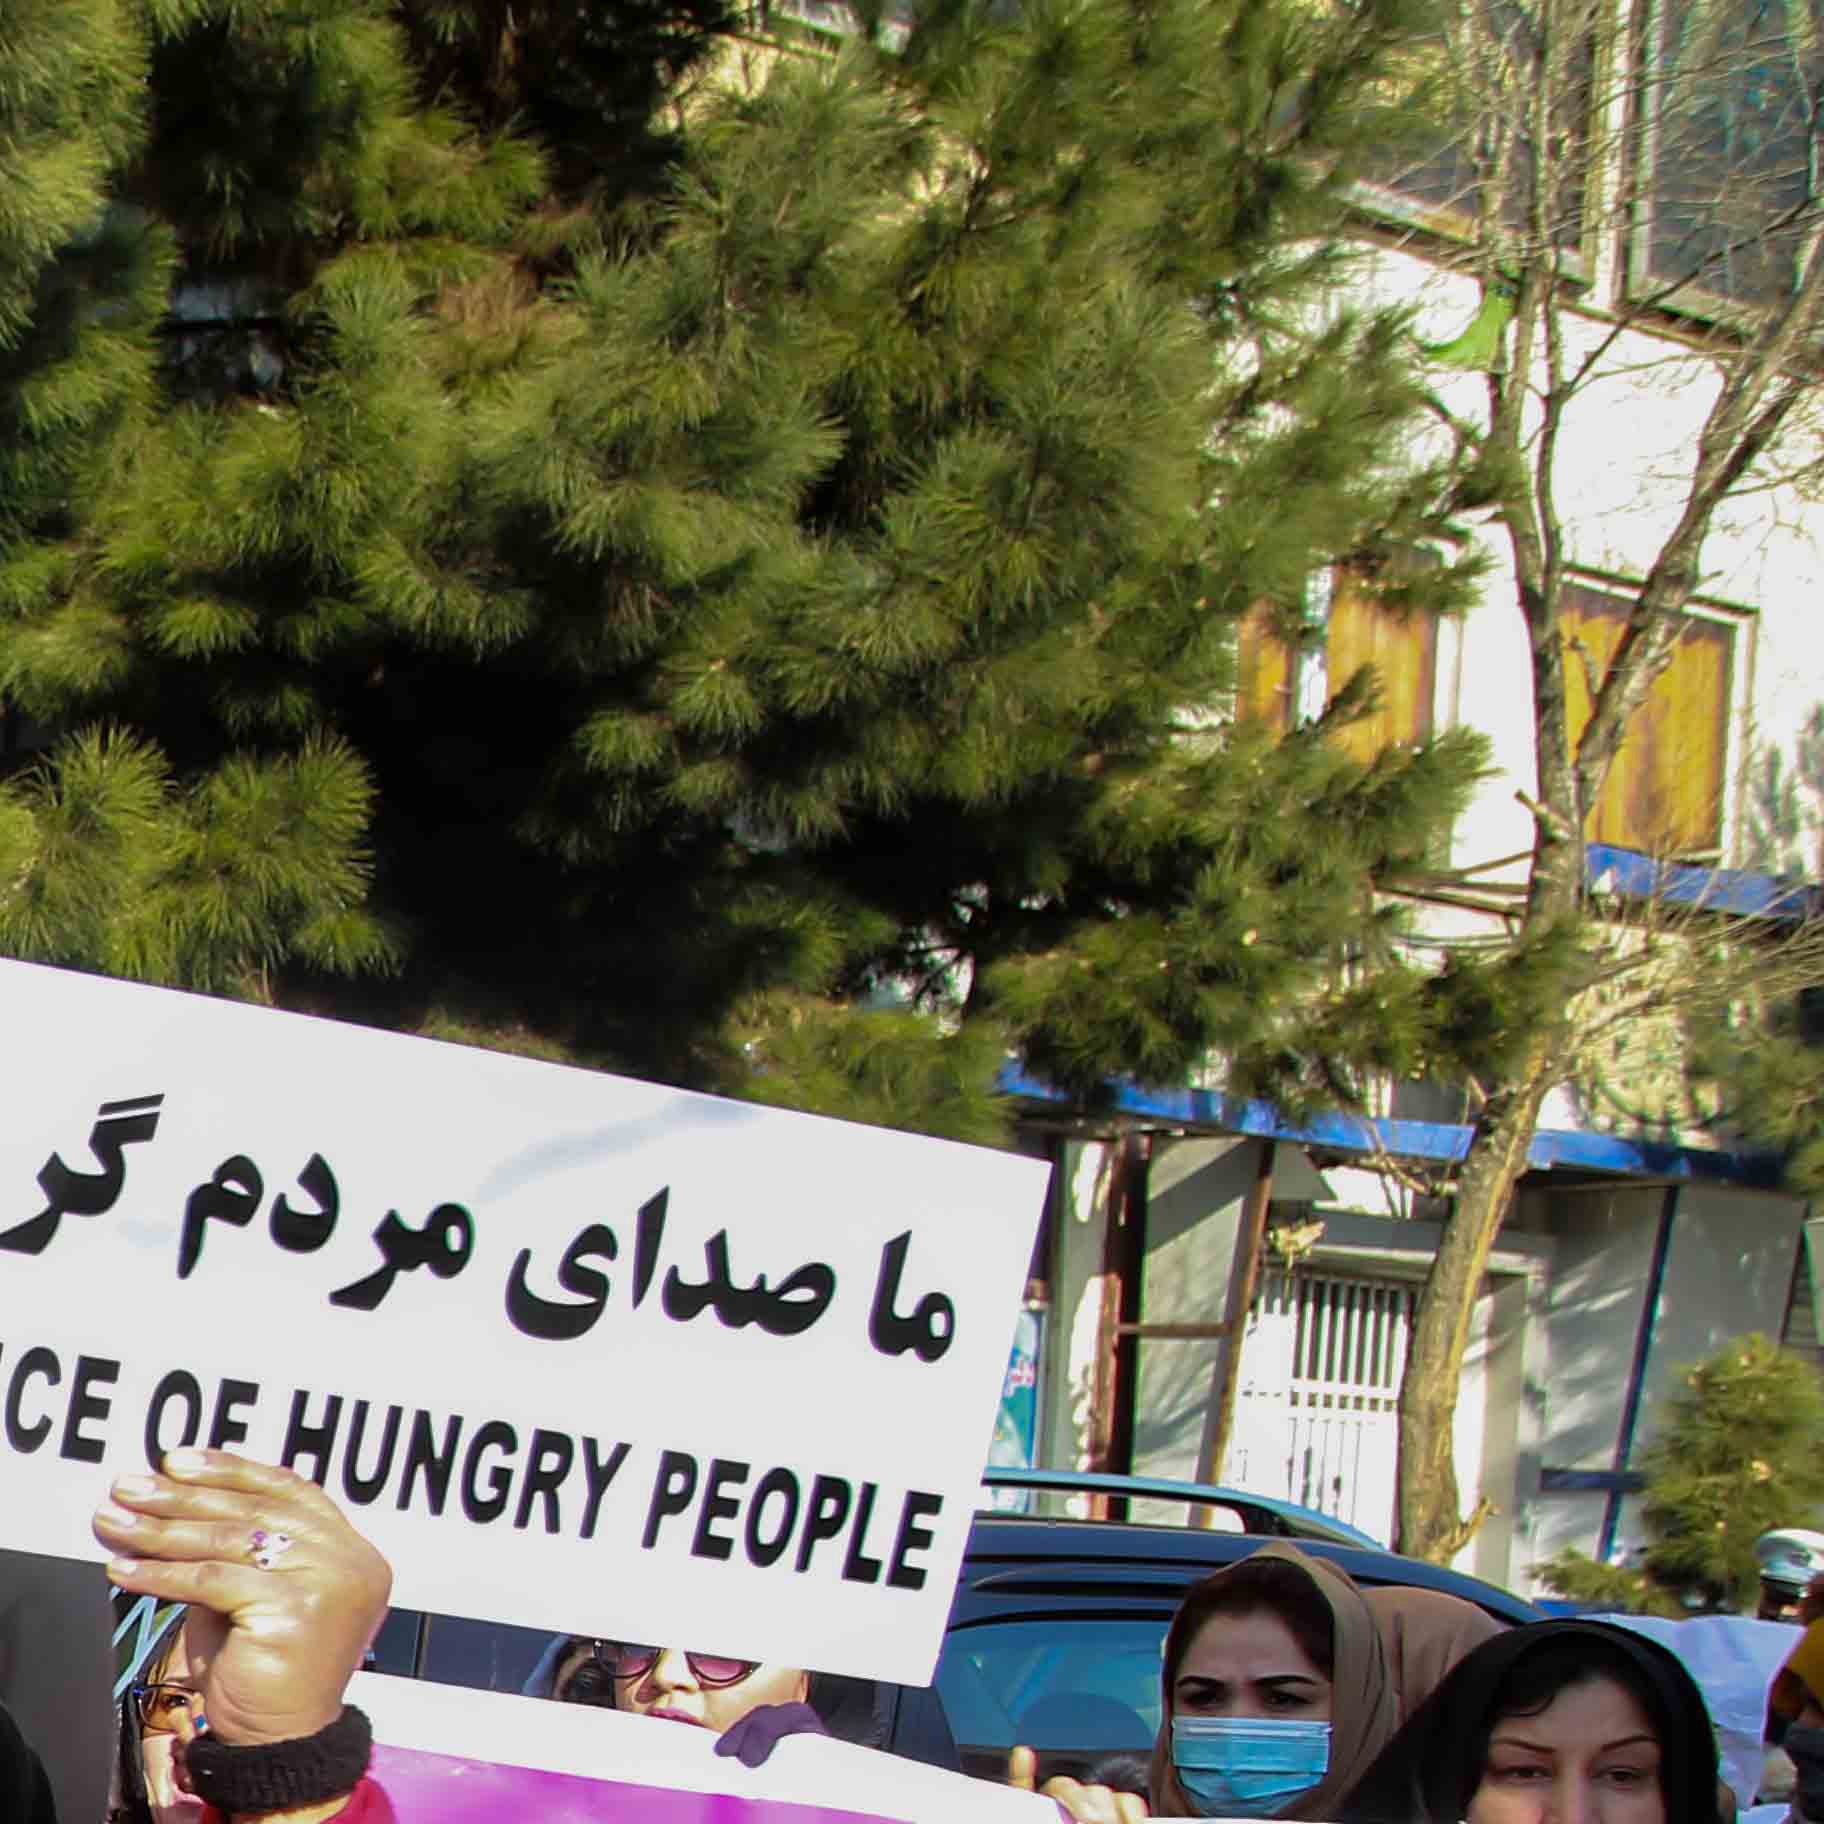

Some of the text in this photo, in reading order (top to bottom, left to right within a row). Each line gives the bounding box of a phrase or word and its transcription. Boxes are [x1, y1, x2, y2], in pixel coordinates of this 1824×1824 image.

[177, 1152, 475, 1312] مردم
[505, 1186, 836, 1340] صدای
[868, 1229, 956, 1364] ما
[144, 1368, 260, 1470] OF
[280, 1389, 631, 1541] HUNGRY
[641, 1448, 945, 1591] PEOPLE
